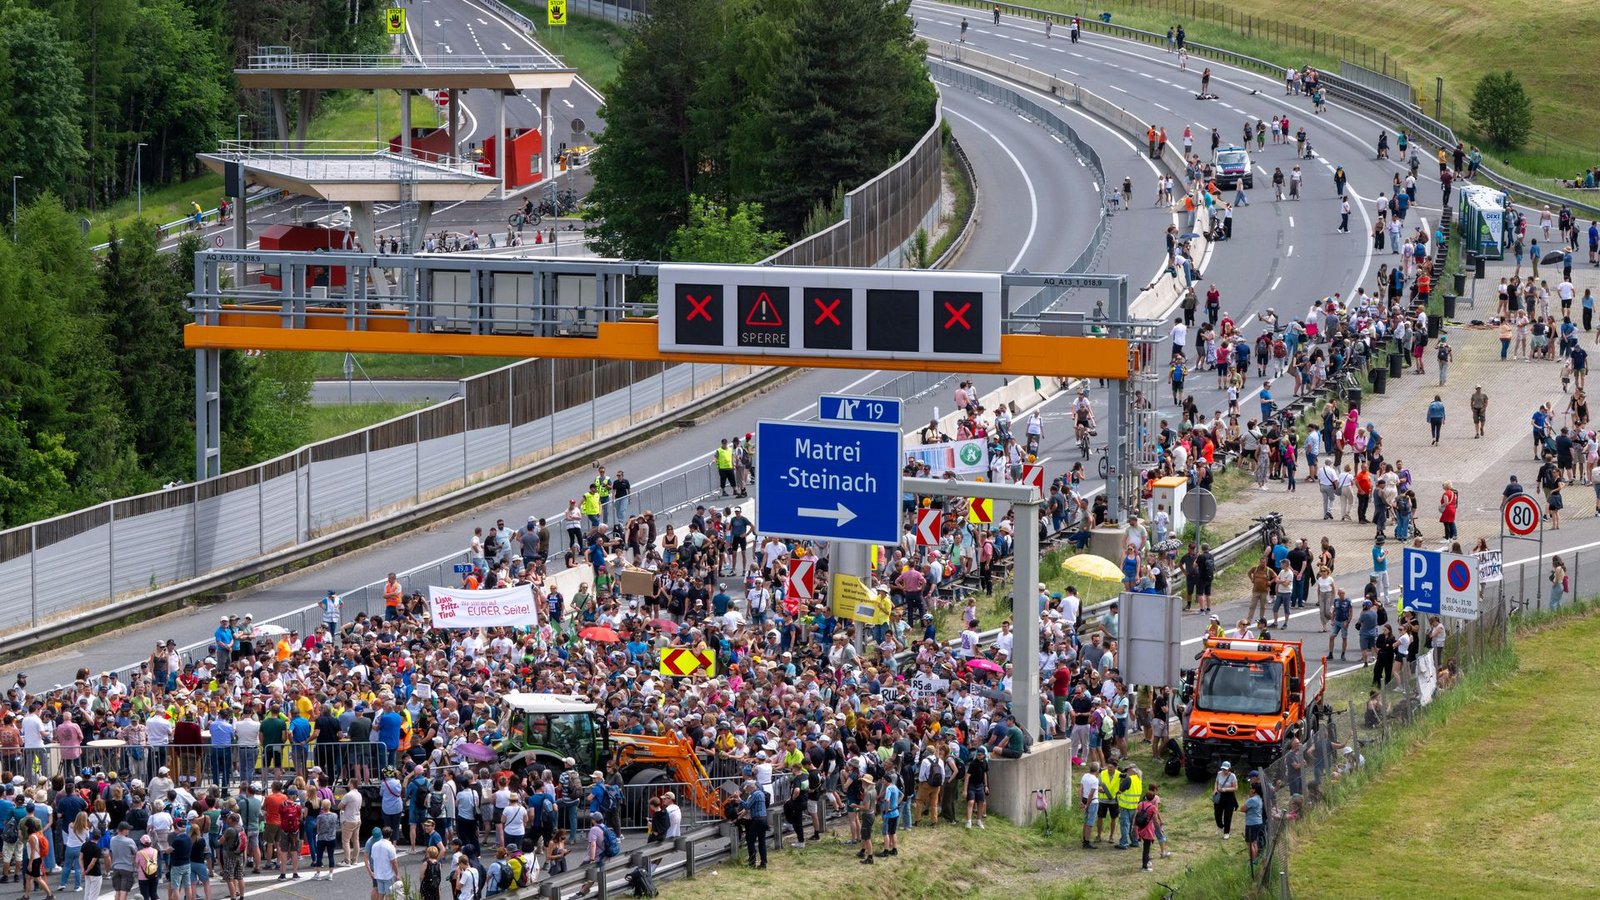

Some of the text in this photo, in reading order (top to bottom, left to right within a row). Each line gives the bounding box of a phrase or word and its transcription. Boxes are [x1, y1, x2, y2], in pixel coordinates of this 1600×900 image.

[742, 332, 787, 344] SPERRE
[866, 403, 884, 420] 19
[795, 438, 861, 462] Matrei
[780, 466, 877, 493] -Steinach
[1512, 505, 1531, 526] 80
[1410, 552, 1428, 591] P
[434, 595, 453, 605] Liste
[438, 610, 456, 620] Tirol
[467, 604, 530, 616] EURER Seite!
[912, 680, 932, 690] 85 dB
